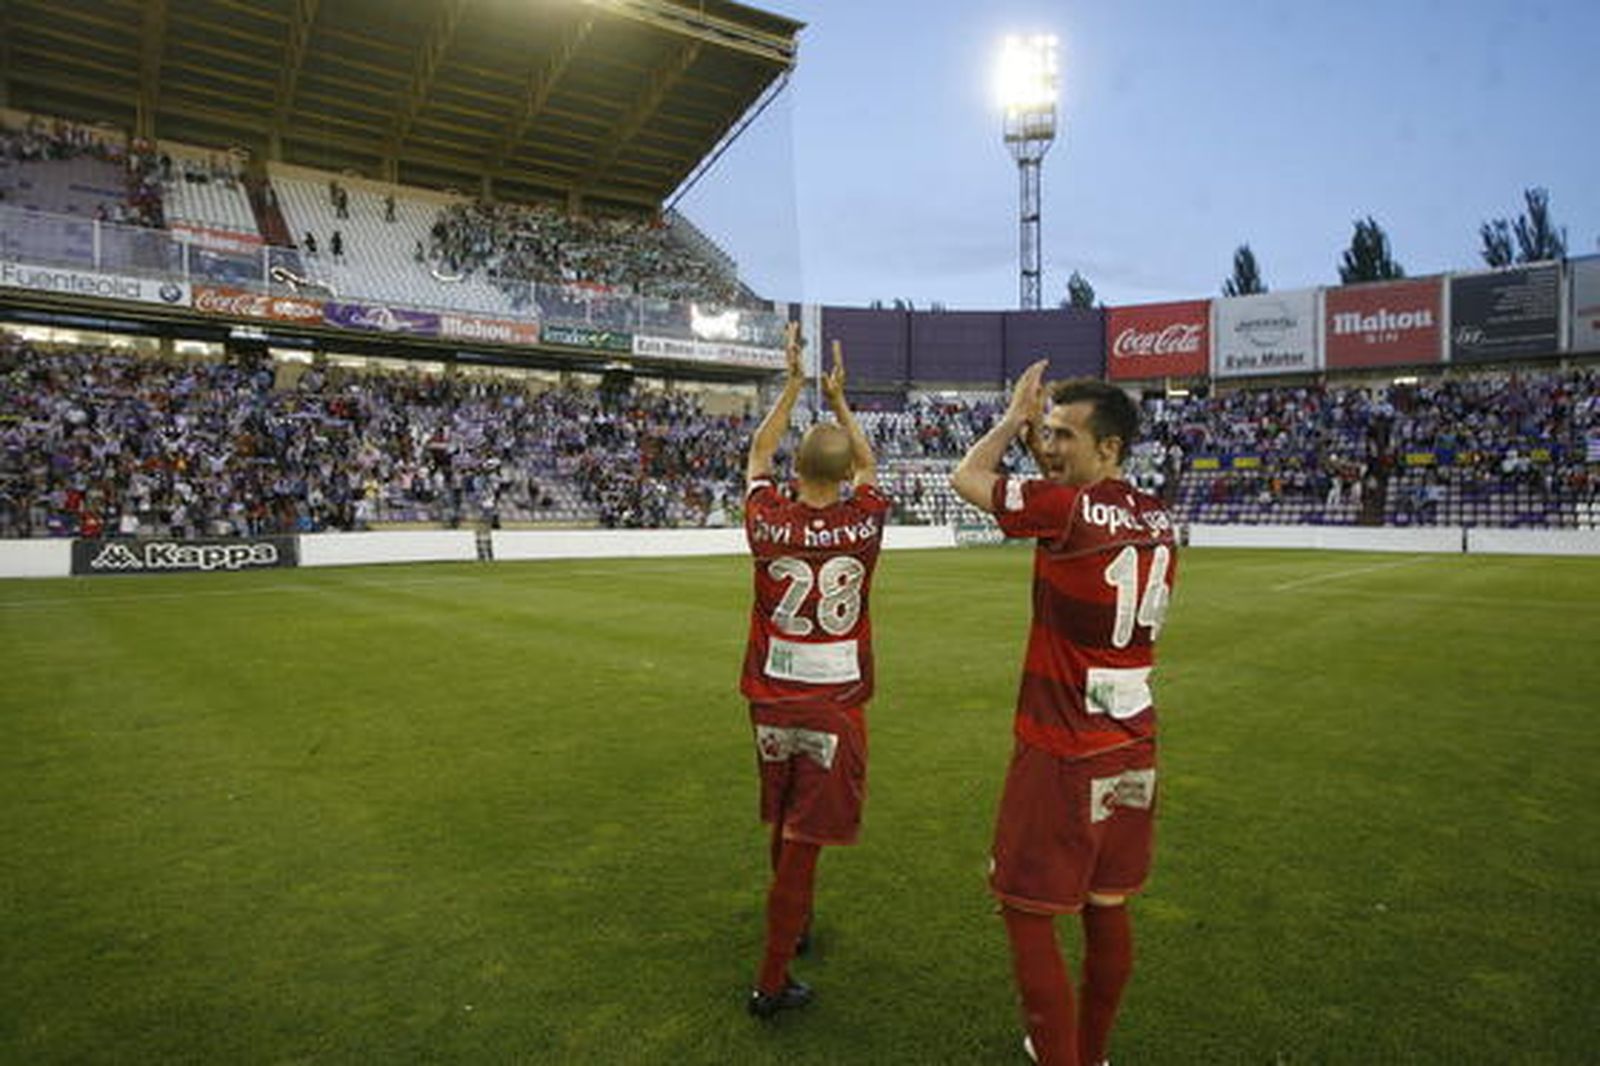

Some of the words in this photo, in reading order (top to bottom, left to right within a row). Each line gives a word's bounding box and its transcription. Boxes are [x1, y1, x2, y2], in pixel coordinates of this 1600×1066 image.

[1333, 308, 1434, 335] Mahou
[145, 542, 278, 570] Kappa
[768, 556, 865, 636] 28
